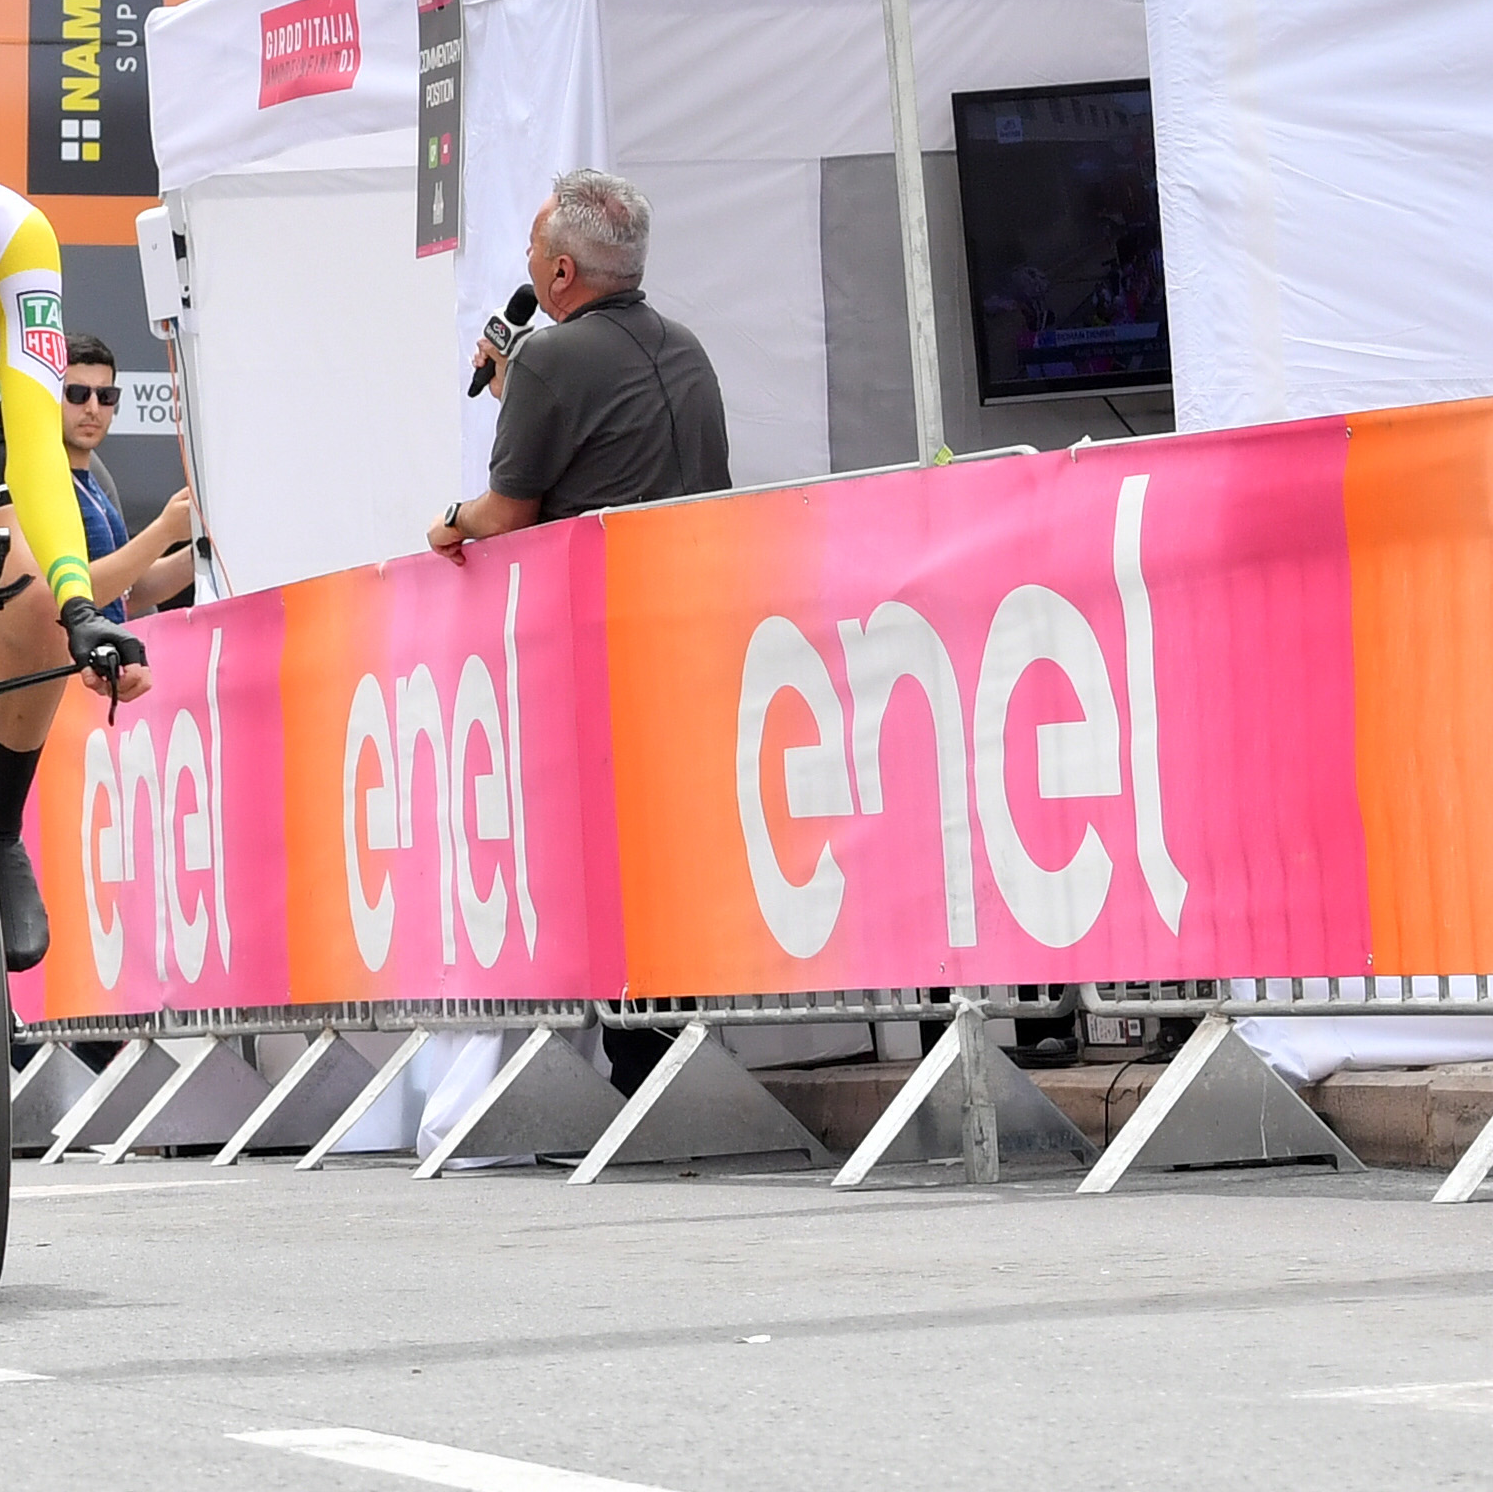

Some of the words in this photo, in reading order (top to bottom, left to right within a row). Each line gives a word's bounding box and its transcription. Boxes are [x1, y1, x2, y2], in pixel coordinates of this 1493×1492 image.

[425, 77, 455, 109] POSITION
[133, 384, 180, 402] WO
[81, 627, 231, 990] enel
[343, 562, 539, 973] enel
[737, 474, 1189, 959] enel
